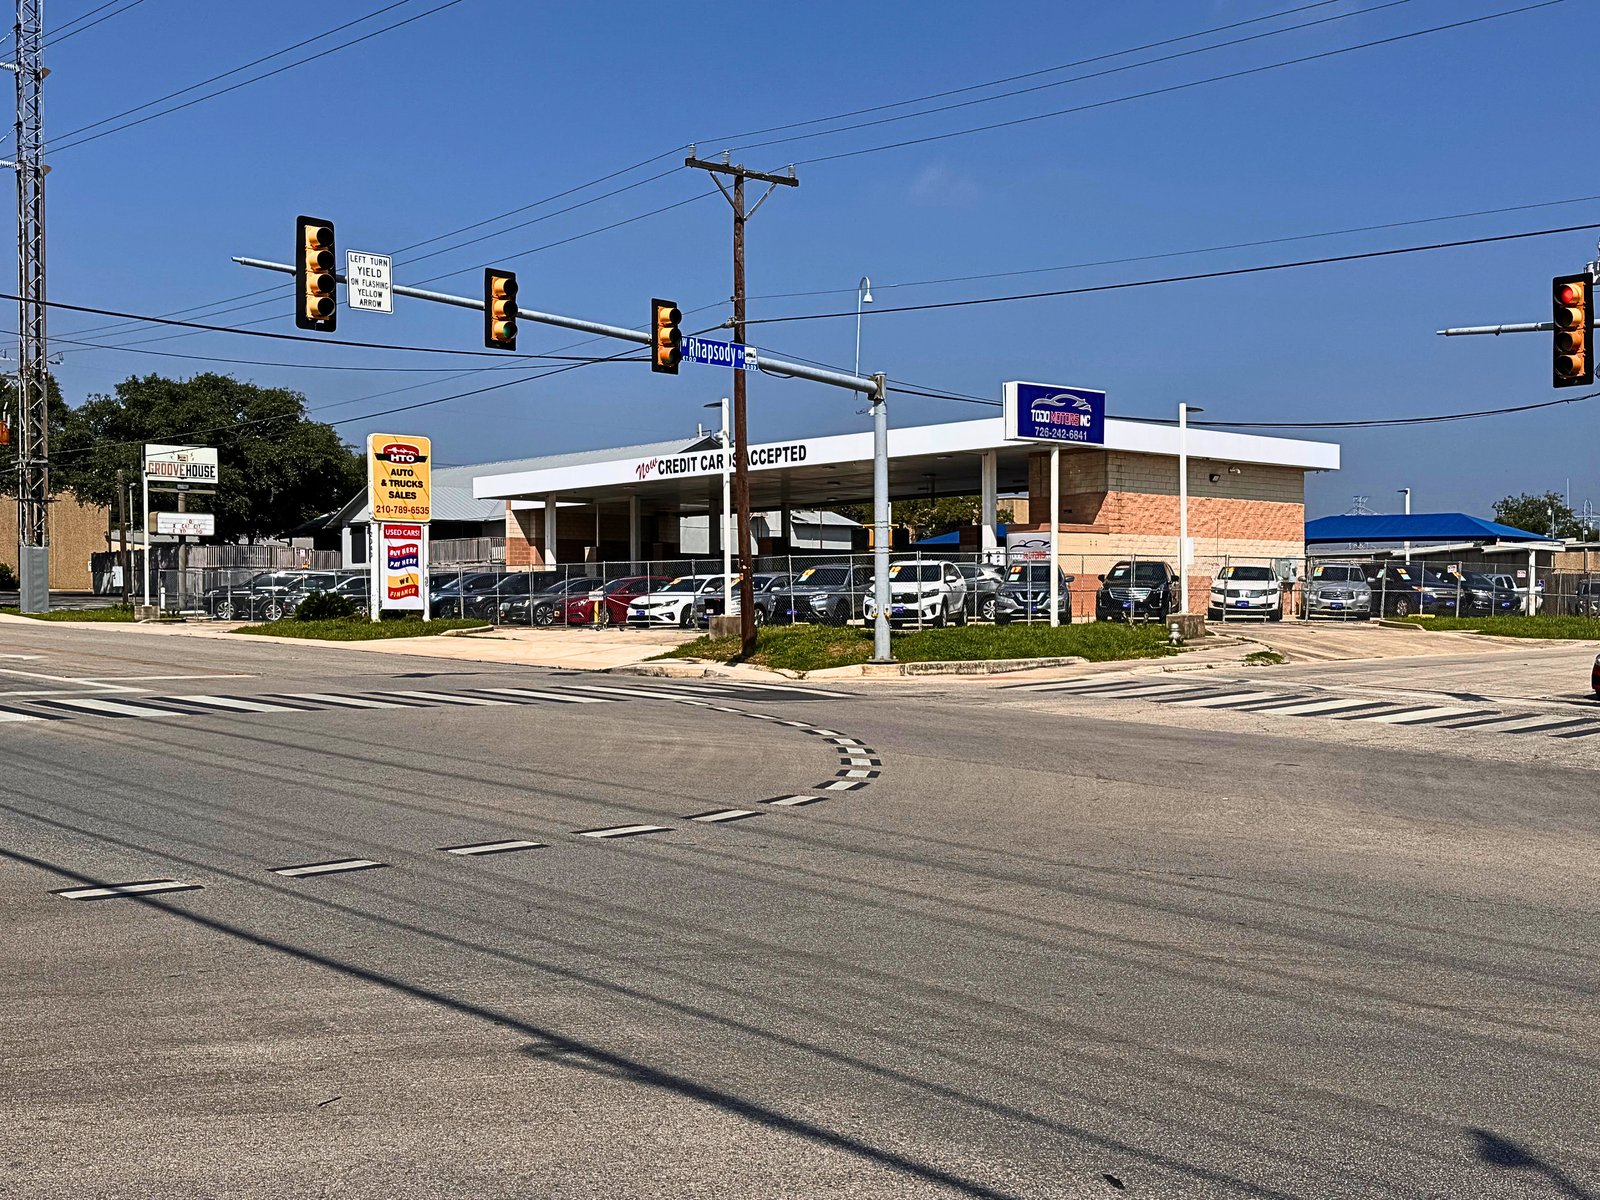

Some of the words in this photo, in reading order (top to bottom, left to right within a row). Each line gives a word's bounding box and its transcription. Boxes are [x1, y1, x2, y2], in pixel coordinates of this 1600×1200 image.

[350, 254, 366, 263] LEFT
[370, 258, 388, 266] TURN
[358, 266, 382, 278] YIELD
[362, 279, 388, 290] FLASHING
[358, 288, 382, 298] YELLOW
[360, 298, 382, 308] ARROW
[682, 338, 688, 346] W
[689, 338, 736, 366] Rhapsody
[738, 349, 744, 360] Dr
[1050, 411, 1079, 426] MOTORS
[1034, 426, 1087, 440] 726-242-6841
[390, 454, 414, 462] HTO
[658, 456, 698, 475] CREDIT
[390, 468, 414, 476] AUTO
[389, 480, 424, 488] TRUCKS
[388, 491, 416, 500] SALES
[376, 505, 430, 514] 210-789-6535
[402, 546, 417, 554] HERE
[400, 577, 409, 585] WE
[390, 588, 415, 598] FINANCE
